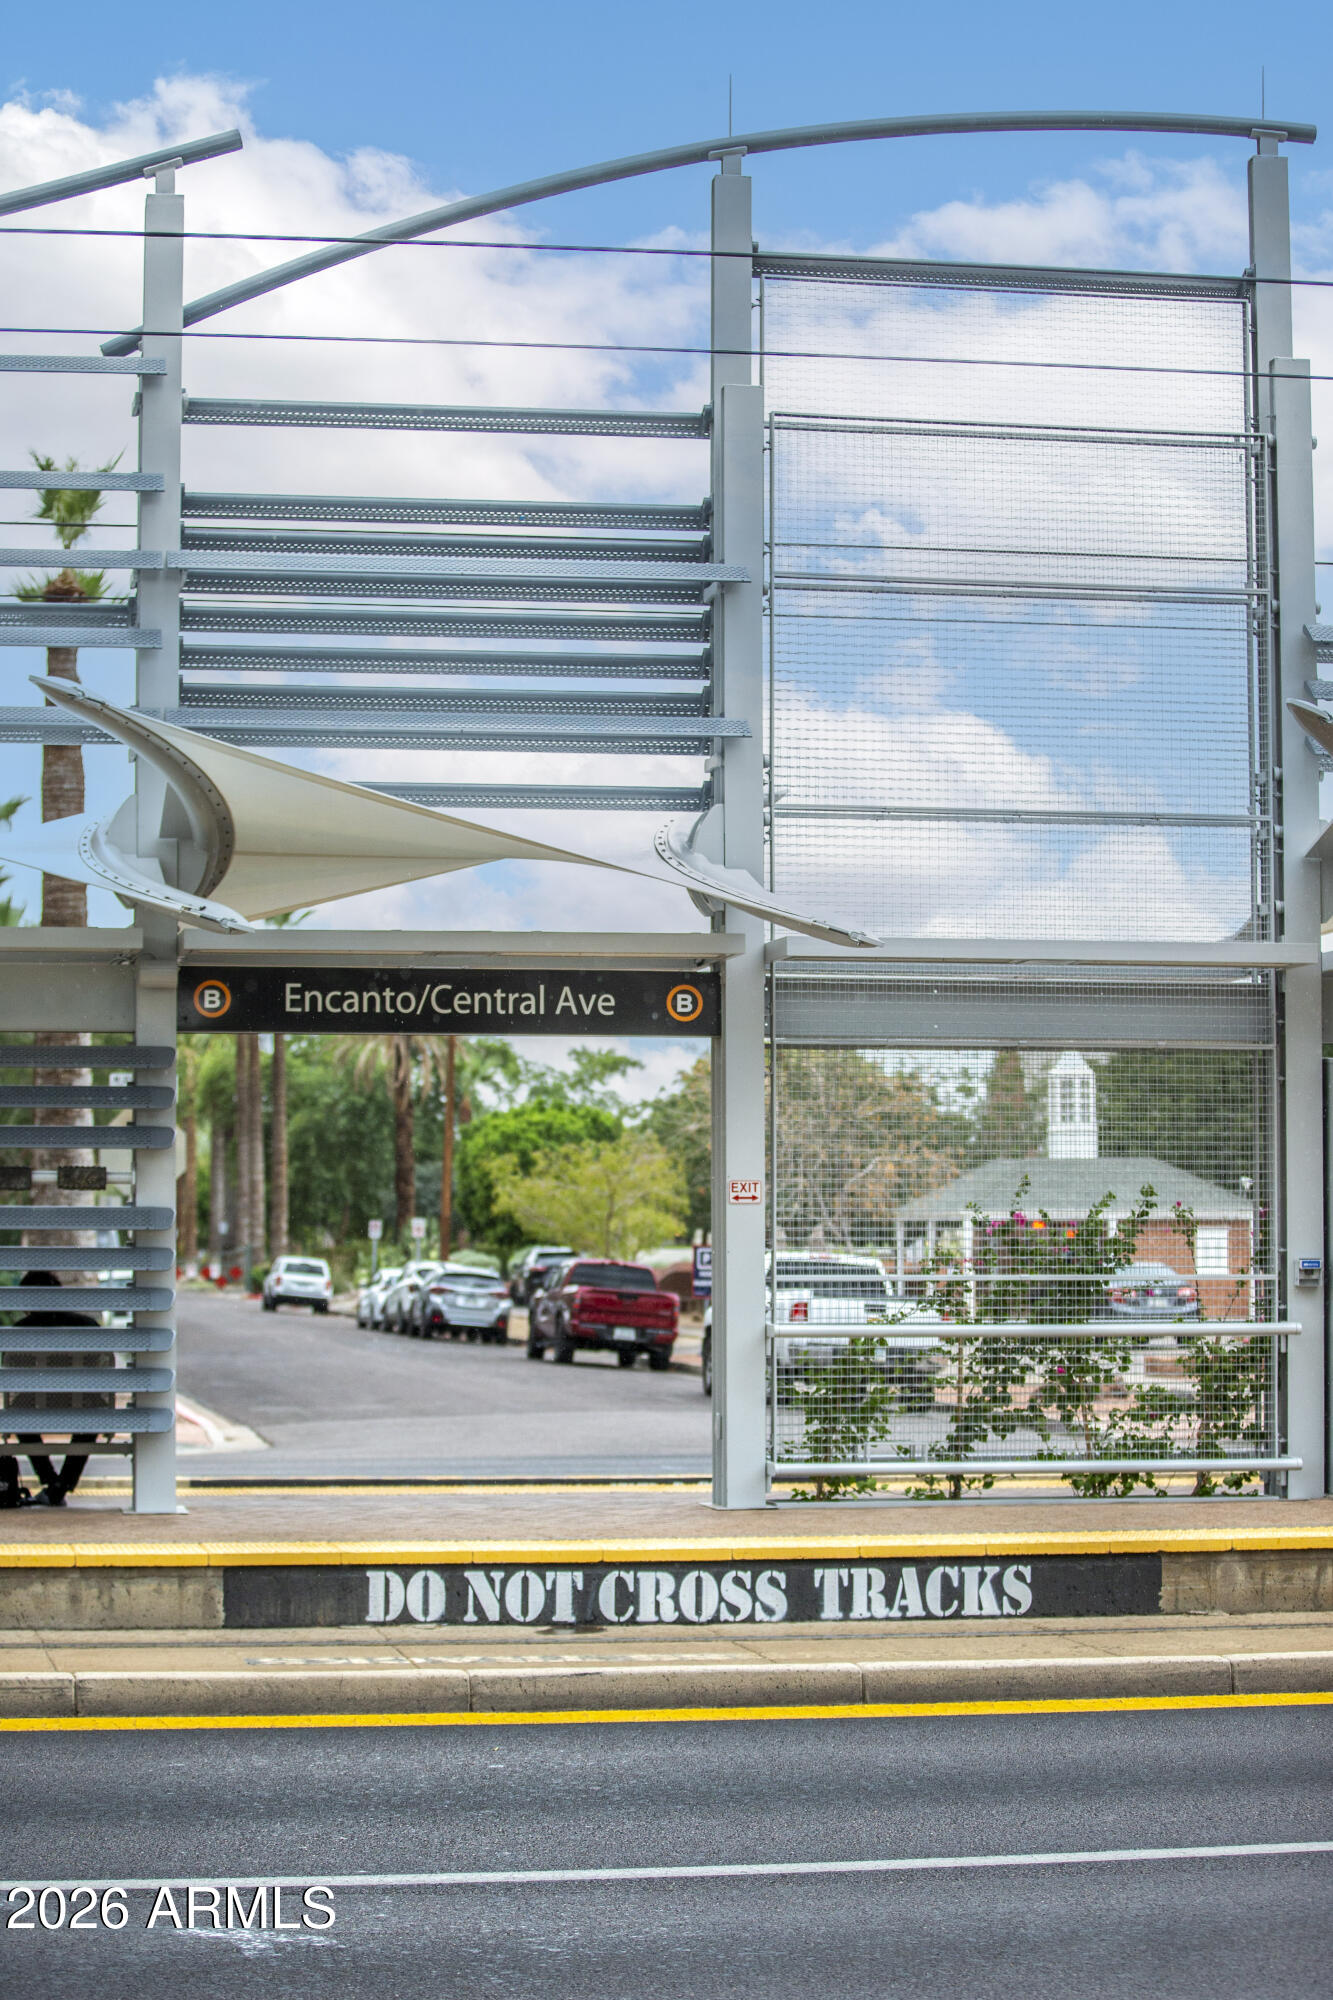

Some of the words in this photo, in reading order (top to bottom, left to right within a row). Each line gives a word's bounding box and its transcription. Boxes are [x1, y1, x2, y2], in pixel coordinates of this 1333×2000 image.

[204, 989, 221, 1009] B
[285, 983, 546, 1015] Encanto/Central
[555, 986, 616, 1016] Ave
[676, 993, 693, 1013] B
[731, 1182, 759, 1193] EXIT
[366, 1570, 446, 1622] DO
[463, 1570, 584, 1623] NOT
[598, 1569, 788, 1623] CROSS
[813, 1564, 1033, 1619] TRACKS
